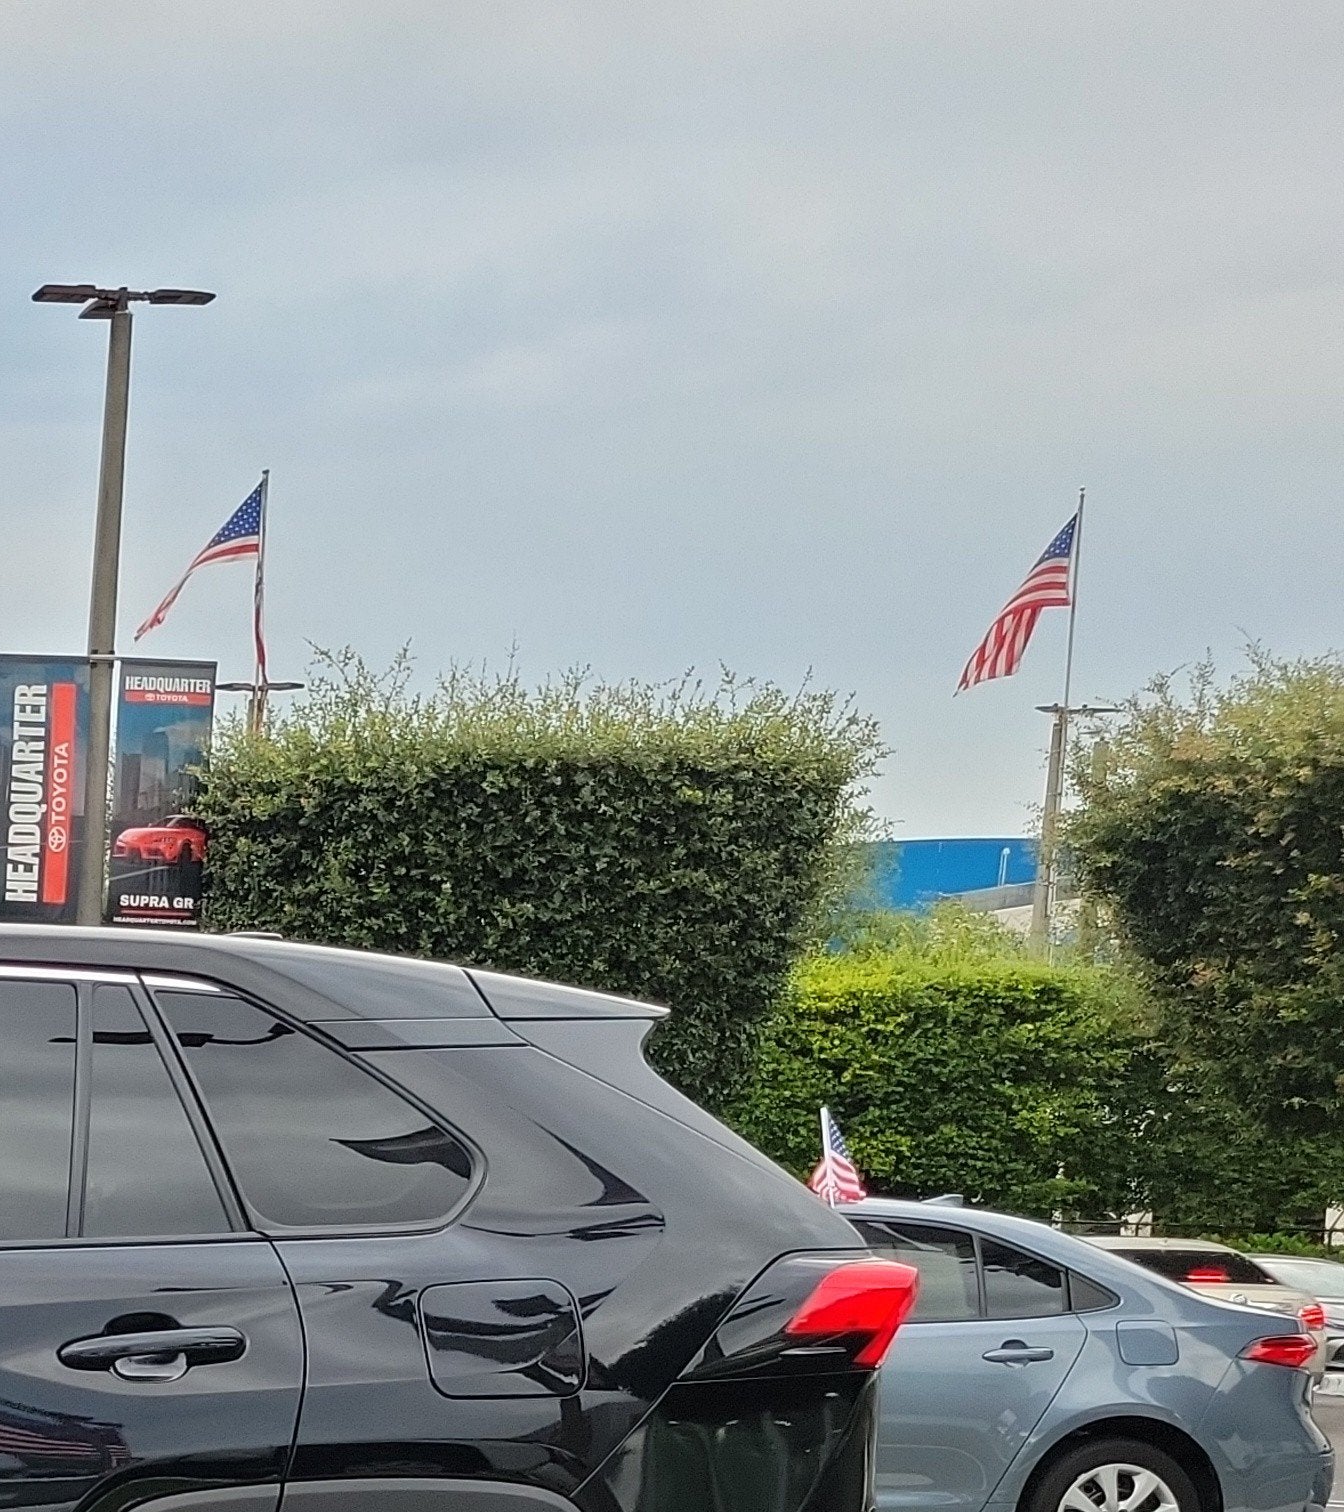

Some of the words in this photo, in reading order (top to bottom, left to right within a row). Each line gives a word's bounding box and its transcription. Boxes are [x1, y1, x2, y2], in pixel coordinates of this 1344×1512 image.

[125, 676, 211, 693] HEADQUARTER
[156, 693, 189, 702] TOYOTA
[50, 742, 70, 824] TOYOTA
[4, 683, 48, 903] HEADQUARTER
[119, 894, 170, 909] SUPRA
[172, 896, 194, 910] GR
